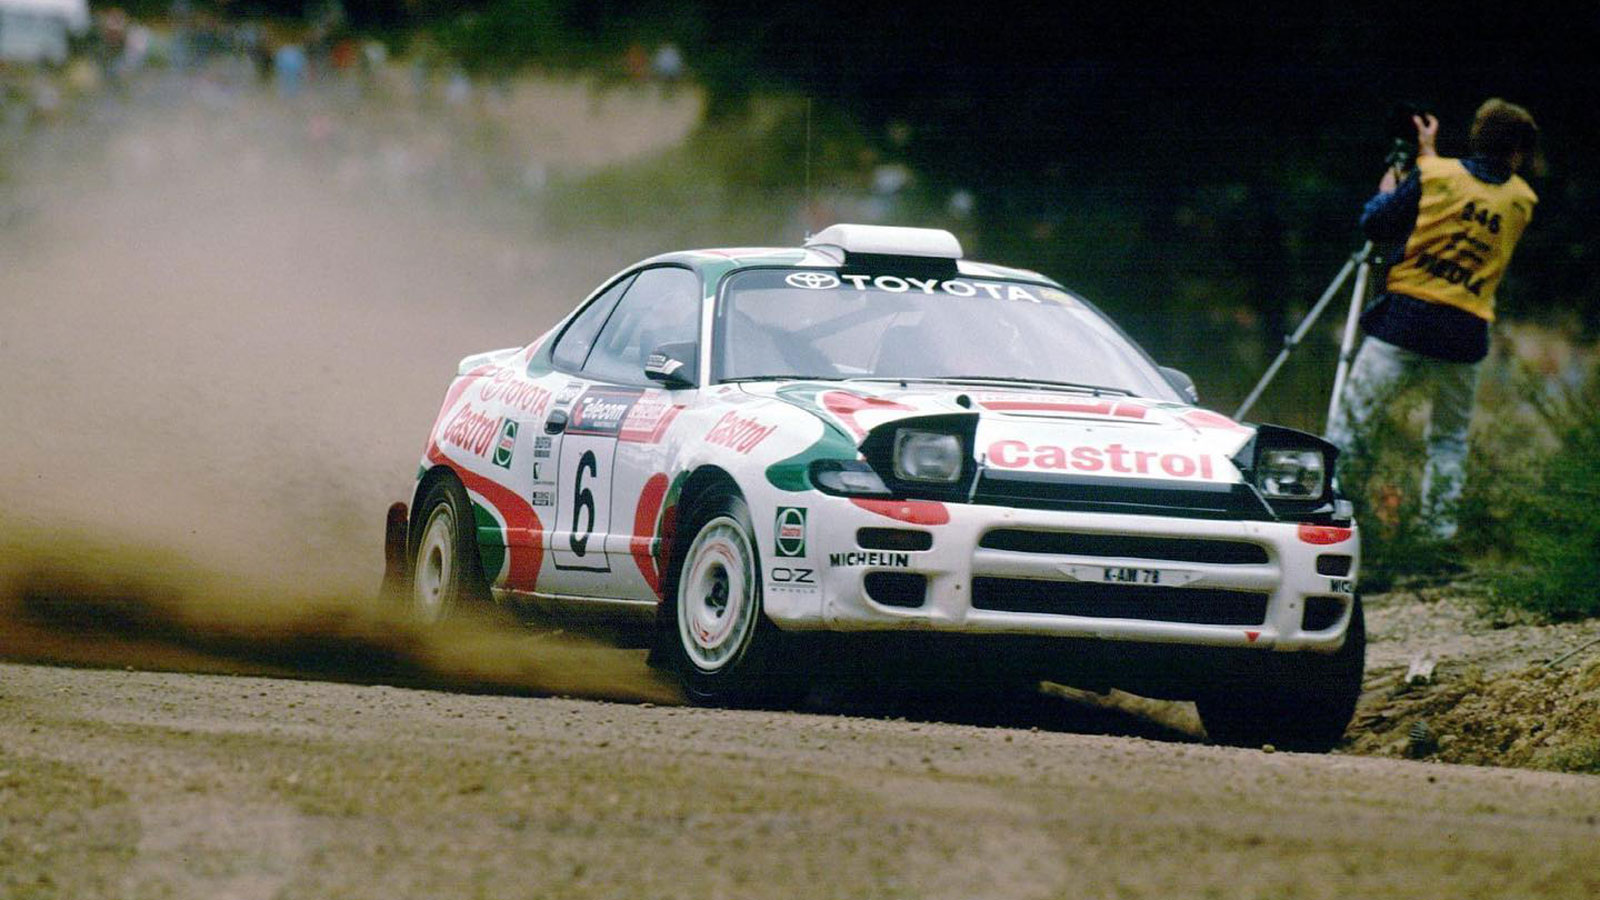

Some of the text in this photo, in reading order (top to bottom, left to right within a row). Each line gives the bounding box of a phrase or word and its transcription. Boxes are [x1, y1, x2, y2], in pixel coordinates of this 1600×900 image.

[842, 274, 1041, 303] TOYOTA
[500, 379, 552, 417] TOYOTA
[576, 397, 628, 424] Telecom
[443, 402, 503, 458] Castrol
[704, 410, 779, 455] Castrol
[987, 439, 1213, 479] Castrol
[569, 449, 597, 557] 6
[829, 552, 909, 568] MICHELIN
